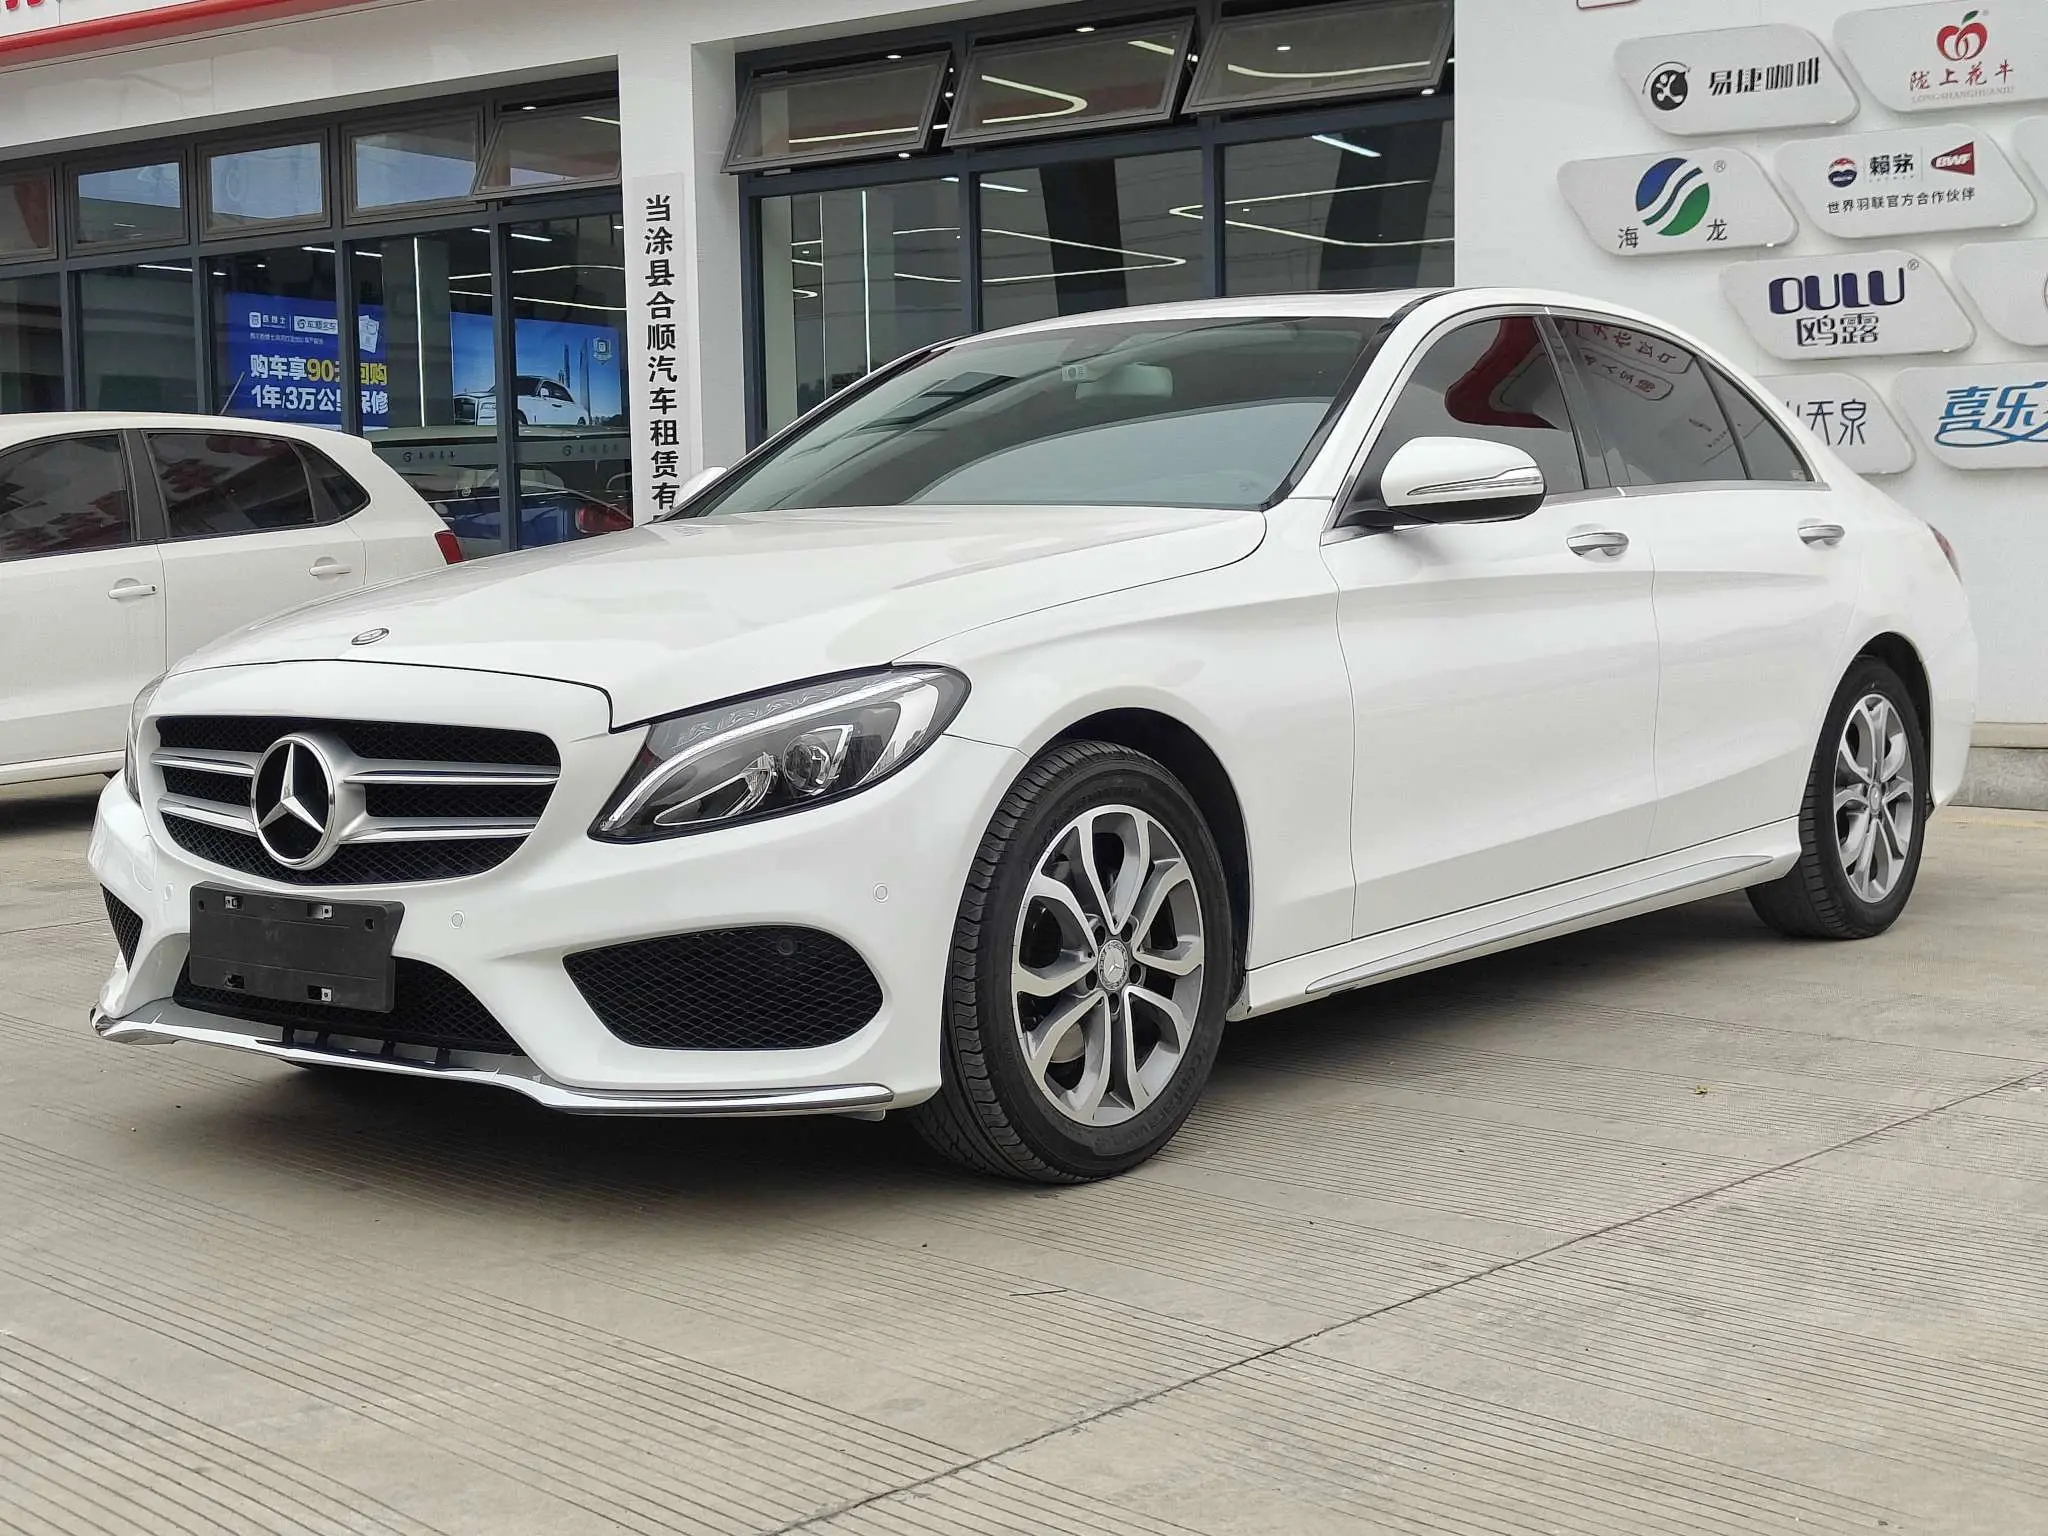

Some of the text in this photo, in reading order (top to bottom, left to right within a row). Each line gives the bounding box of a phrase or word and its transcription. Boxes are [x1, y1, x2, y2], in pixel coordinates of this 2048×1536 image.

[1709, 57, 1820, 97] 易捷咖啡
[1909, 59, 2014, 92] 陇上花牛
[1828, 186, 1976, 215] 世界羽联官方合作伙伴
[1768, 267, 1905, 315] OULU
[1796, 312, 1880, 347] 鸥露
[644, 193, 680, 520] 当涂县合顺汽车租赁有
[1937, 381, 2048, 440] 喜乐
